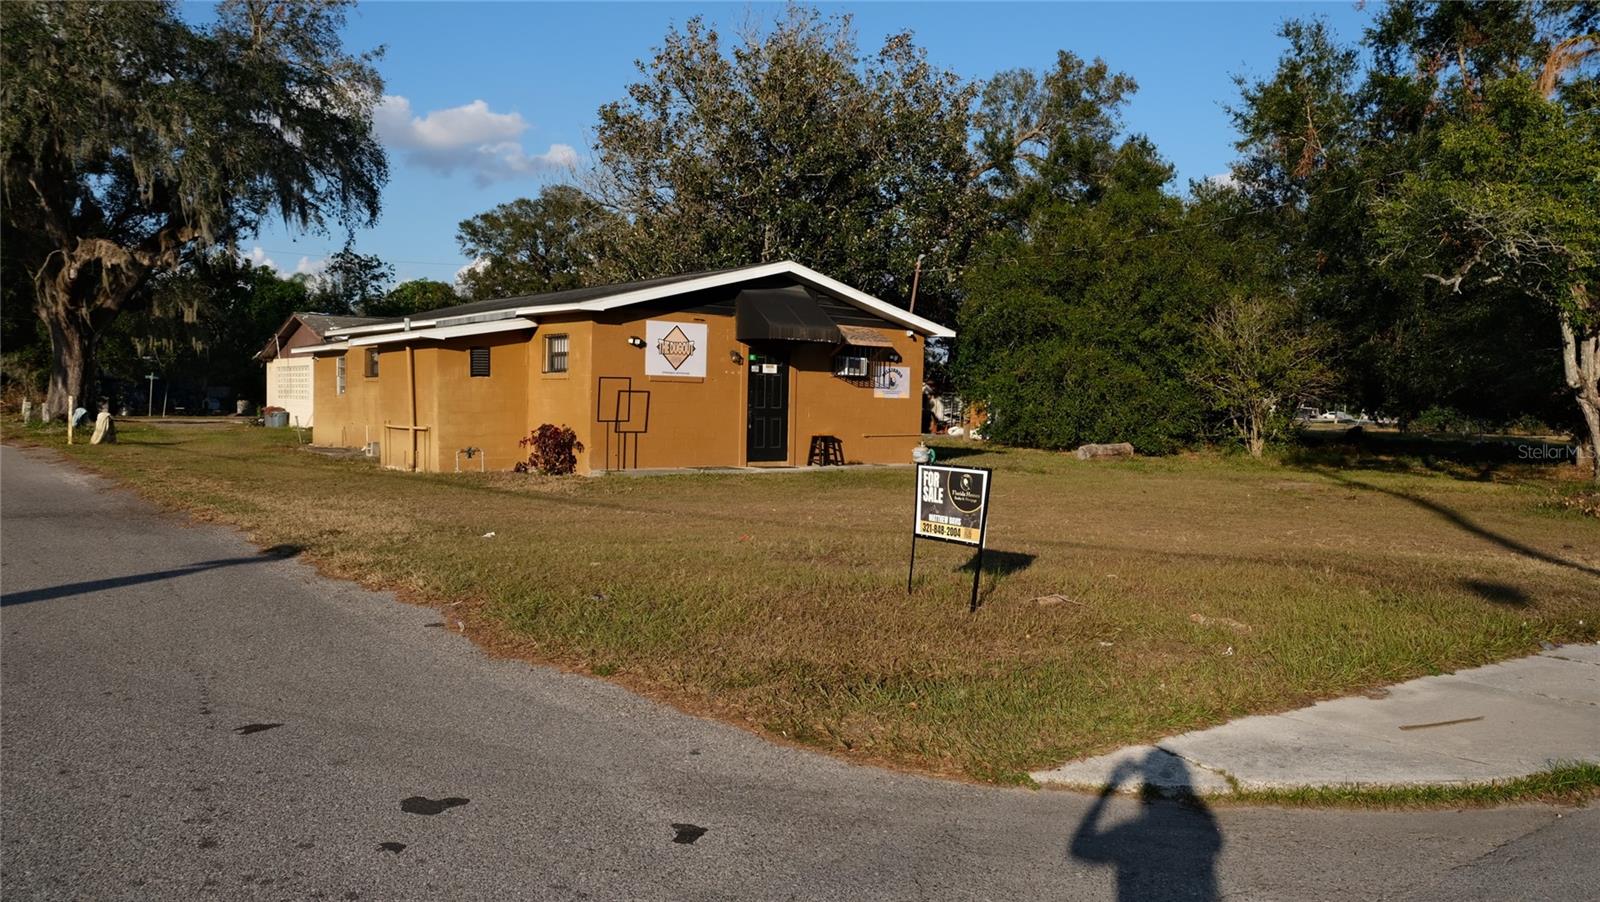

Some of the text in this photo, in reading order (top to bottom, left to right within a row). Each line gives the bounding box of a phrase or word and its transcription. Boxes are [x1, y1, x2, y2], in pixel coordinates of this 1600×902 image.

[658, 338, 695, 356] THE DUGOUT
[923, 470, 940, 488] FOR
[922, 486, 944, 504] SALE
[922, 522, 961, 537] 321-848-2004
